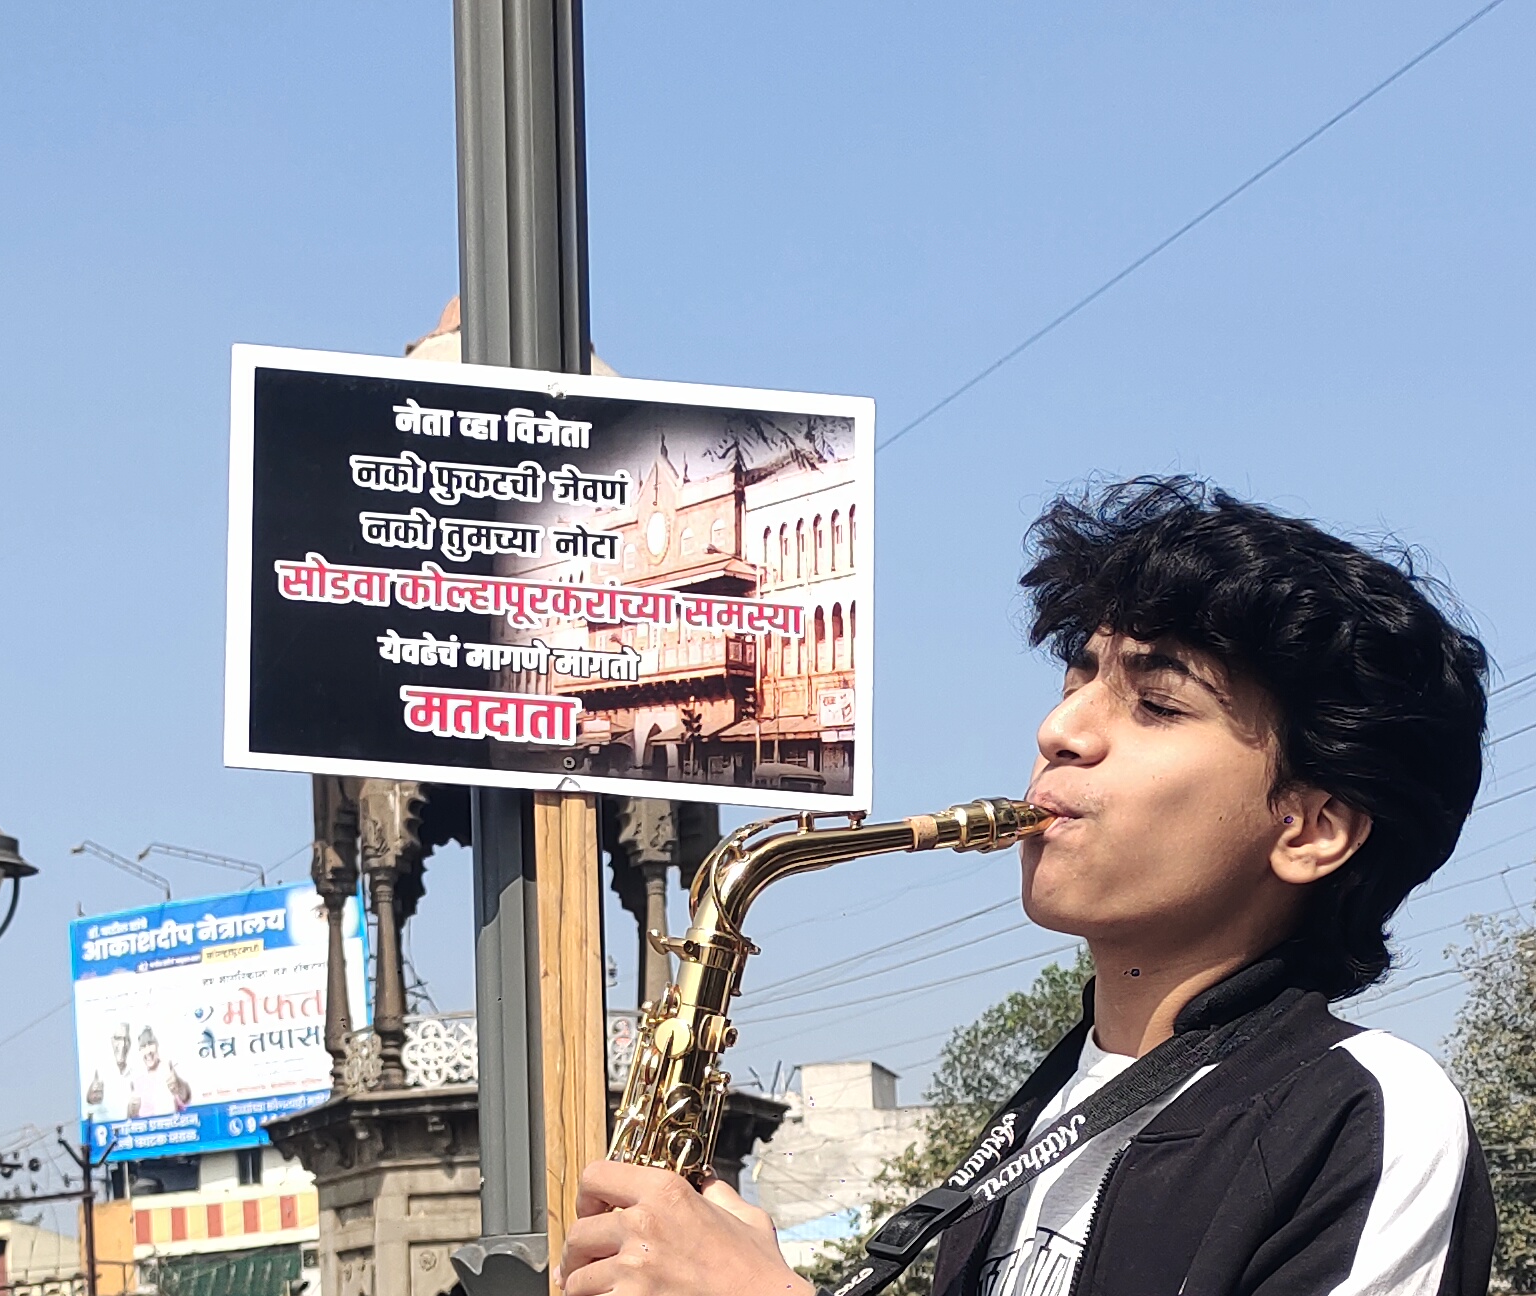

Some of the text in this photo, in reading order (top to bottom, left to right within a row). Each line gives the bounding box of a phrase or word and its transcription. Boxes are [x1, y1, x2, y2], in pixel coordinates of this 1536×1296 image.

[393, 399, 592, 449] नेता व्हा विजेता
[351, 452, 632, 508] नको फुकटची जेवणं
[359, 508, 624, 563] नको तुमच्या नोटा
[275, 553, 805, 637] सोडवा कोल्हापूरकरांच्या समस्या
[377, 630, 640, 682] येवढेचं मागणे मागतो
[402, 687, 581, 745] मतदाता
[81, 908, 286, 961] आकाशदीप नेत्रालय
[223, 987, 324, 1025] मोफत
[198, 1027, 237, 1058] नेत्र
[974, 1115, 1086, 1201] Mithari
